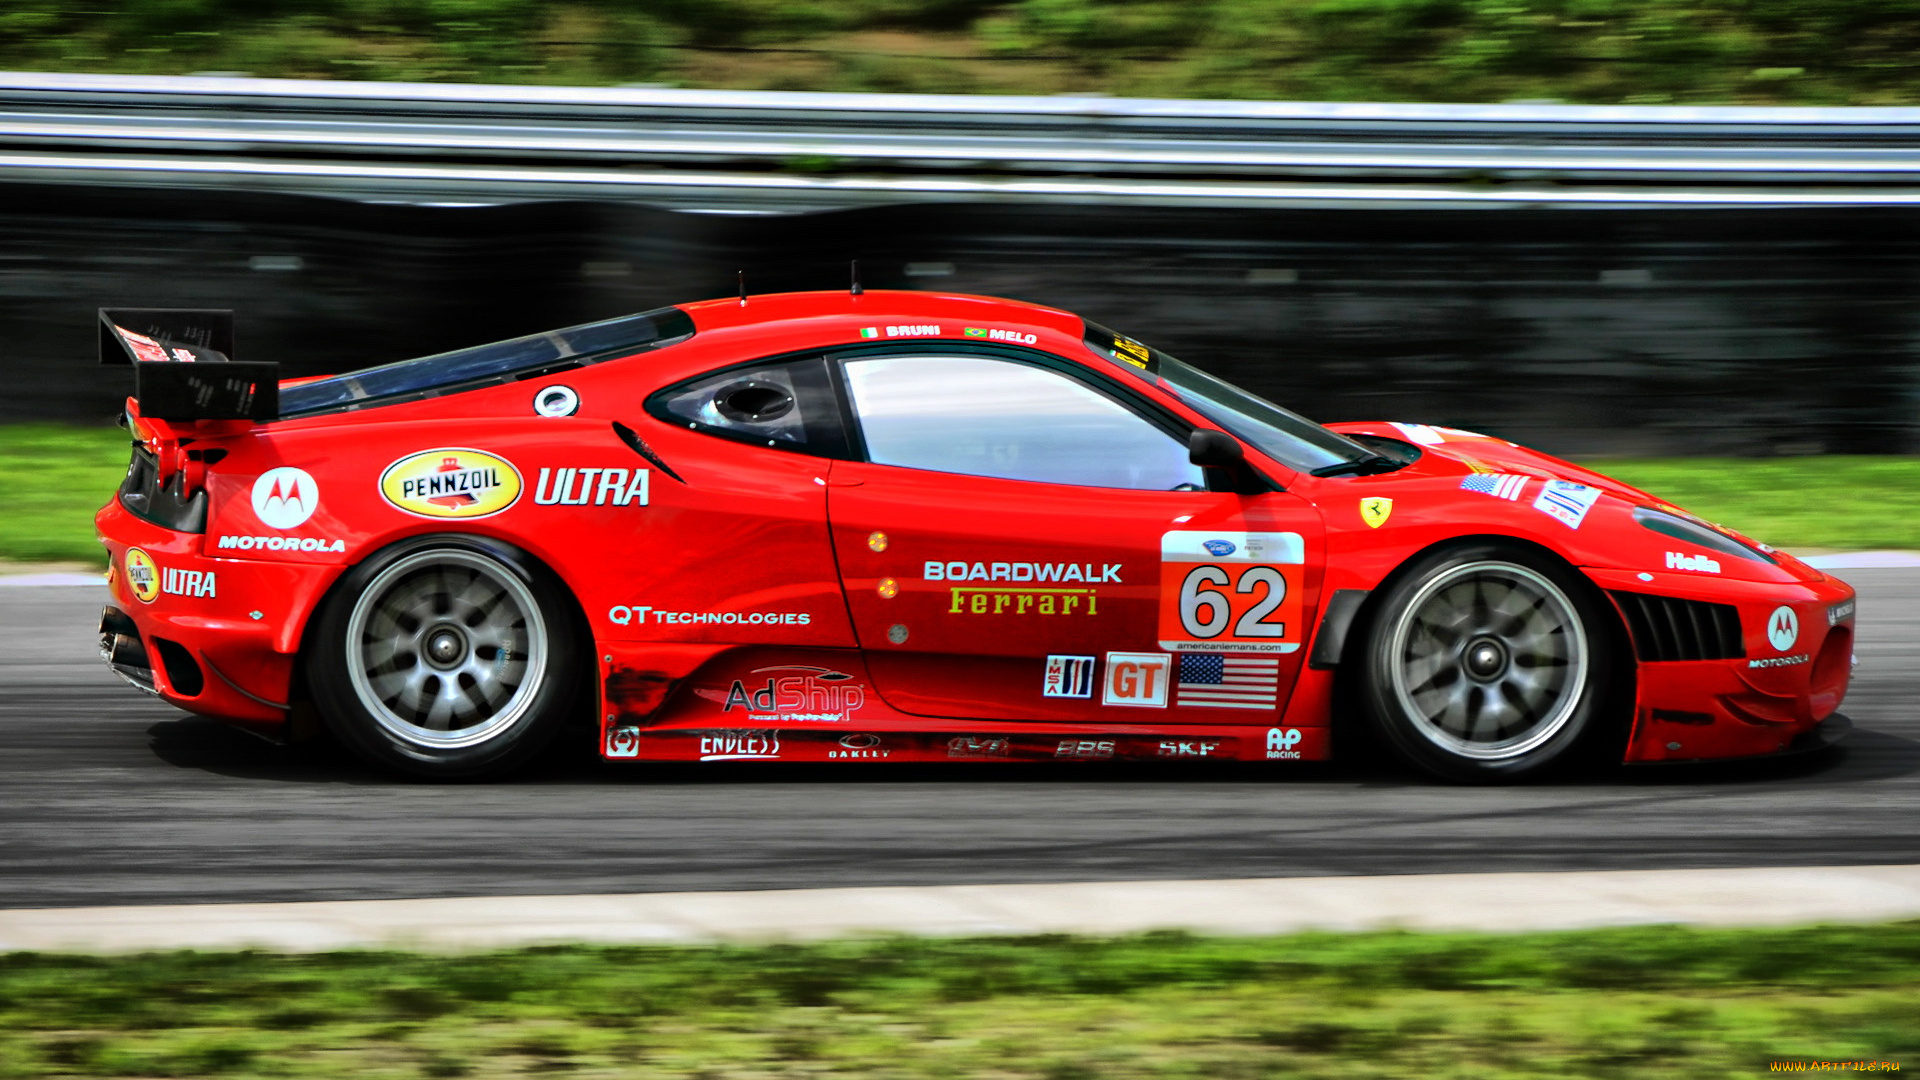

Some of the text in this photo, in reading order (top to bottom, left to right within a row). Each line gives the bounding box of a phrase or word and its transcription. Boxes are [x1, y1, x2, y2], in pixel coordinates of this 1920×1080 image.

[885, 325, 940, 337] BRUNI
[989, 329, 1037, 345] MELO
[403, 467, 501, 498] PENNZOIL
[534, 468, 649, 506] ULTRA
[218, 535, 345, 553] MOTOROLA
[924, 561, 1123, 583] BOARDWALK
[1665, 552, 1721, 573] Hella
[163, 567, 216, 598] ULTRA
[948, 587, 1098, 615] Ferrari
[1179, 565, 1287, 639] 62
[1177, 641, 1281, 652] americanlemans.com
[1748, 654, 1809, 669] MOTOROLA
[1113, 661, 1163, 699] GT
[723, 677, 865, 721] AdShip
[1266, 751, 1301, 759] RACING
